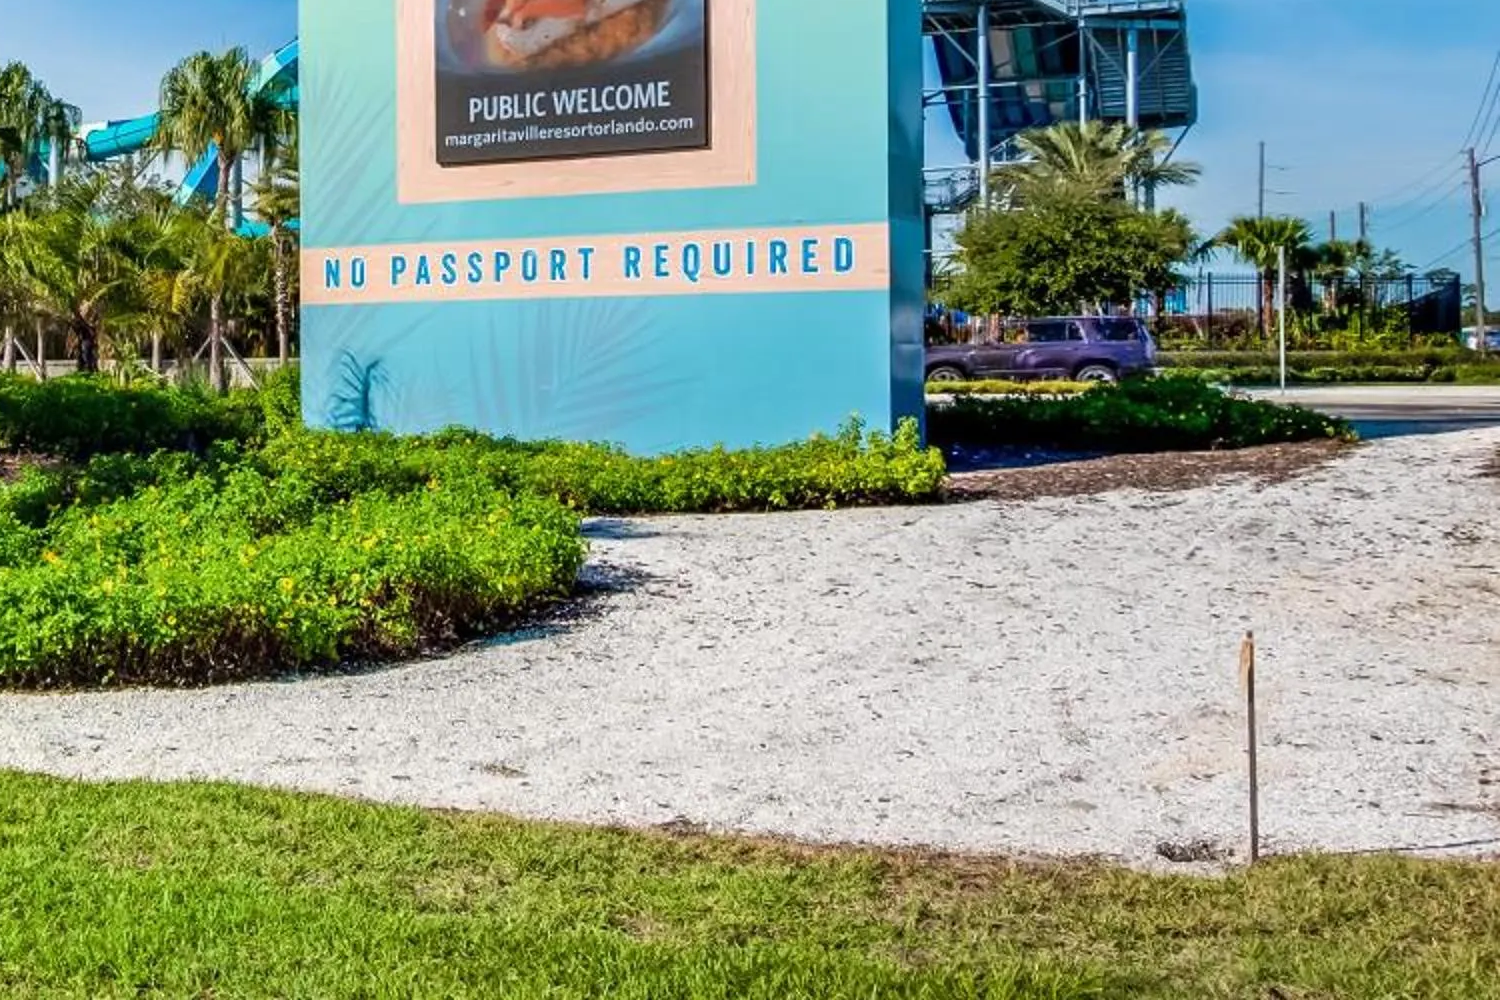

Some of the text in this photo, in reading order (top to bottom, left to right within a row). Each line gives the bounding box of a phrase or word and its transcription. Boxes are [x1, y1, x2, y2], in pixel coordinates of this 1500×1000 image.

[469, 81, 671, 123] PUBLIC WELCOME
[445, 116, 694, 149] margaritavilleresortorlando.com
[325, 236, 855, 289] NO PASSPORT REQUIRED
